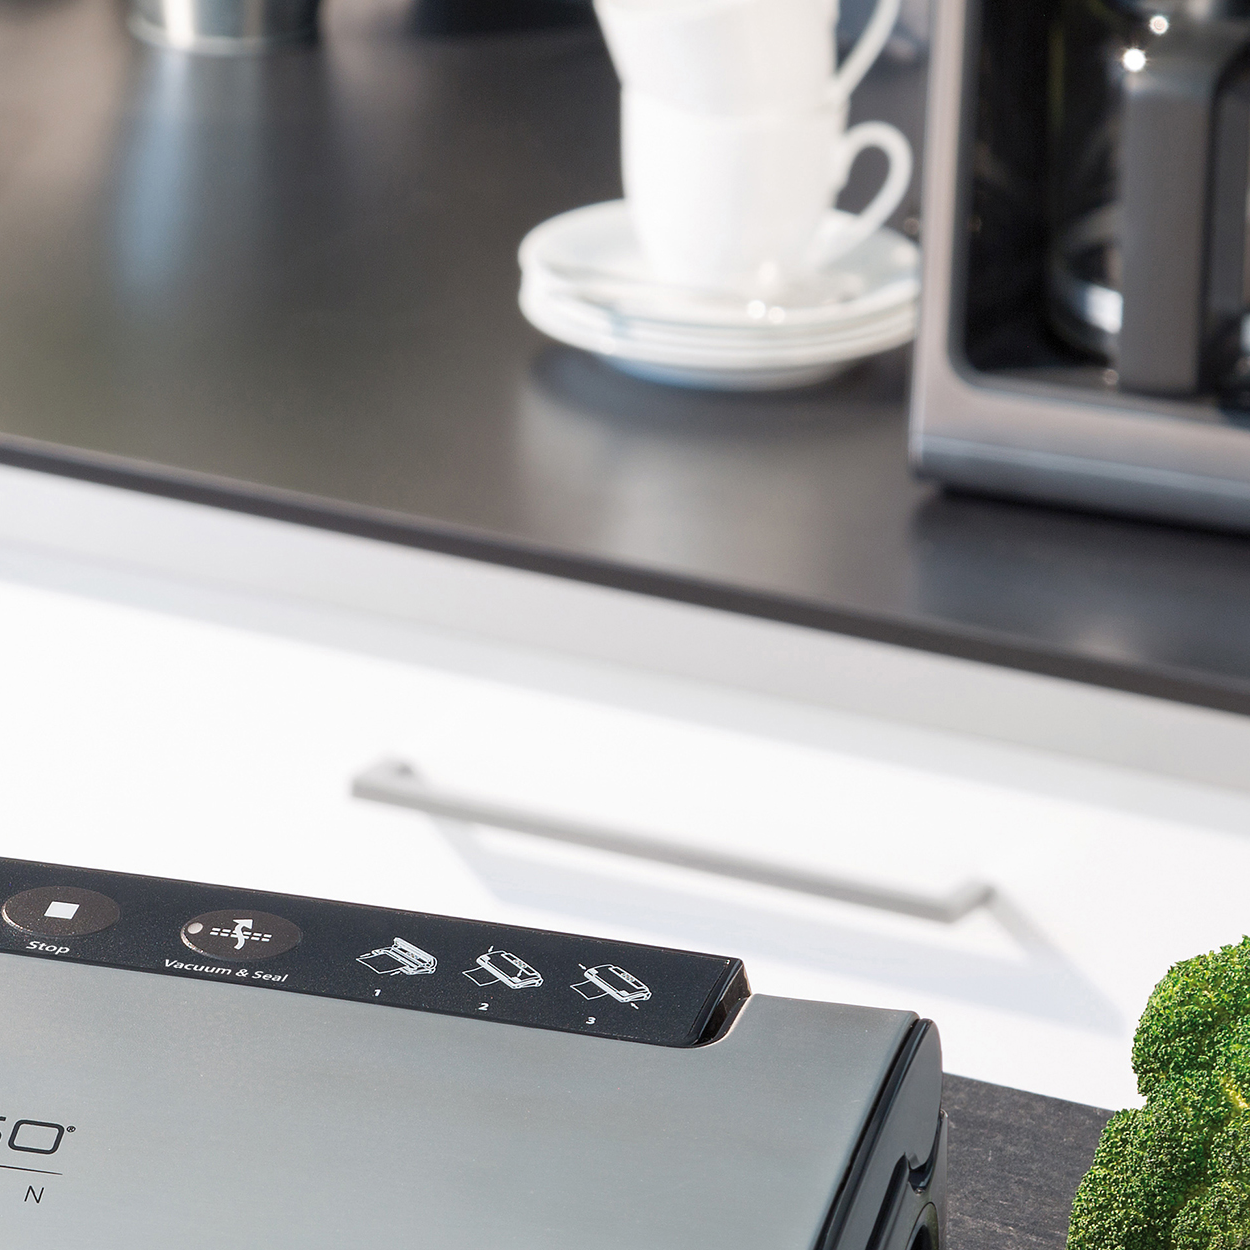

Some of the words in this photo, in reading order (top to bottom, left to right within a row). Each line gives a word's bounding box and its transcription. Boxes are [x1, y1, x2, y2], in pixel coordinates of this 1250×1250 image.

[25, 940, 70, 955] Stop
[163, 958, 232, 976] Vacuum
[235, 968, 249, 978] &
[251, 970, 289, 983] Seal
[373, 989, 382, 997] 1
[478, 1002, 490, 1012] 2
[585, 1016, 597, 1025] 3
